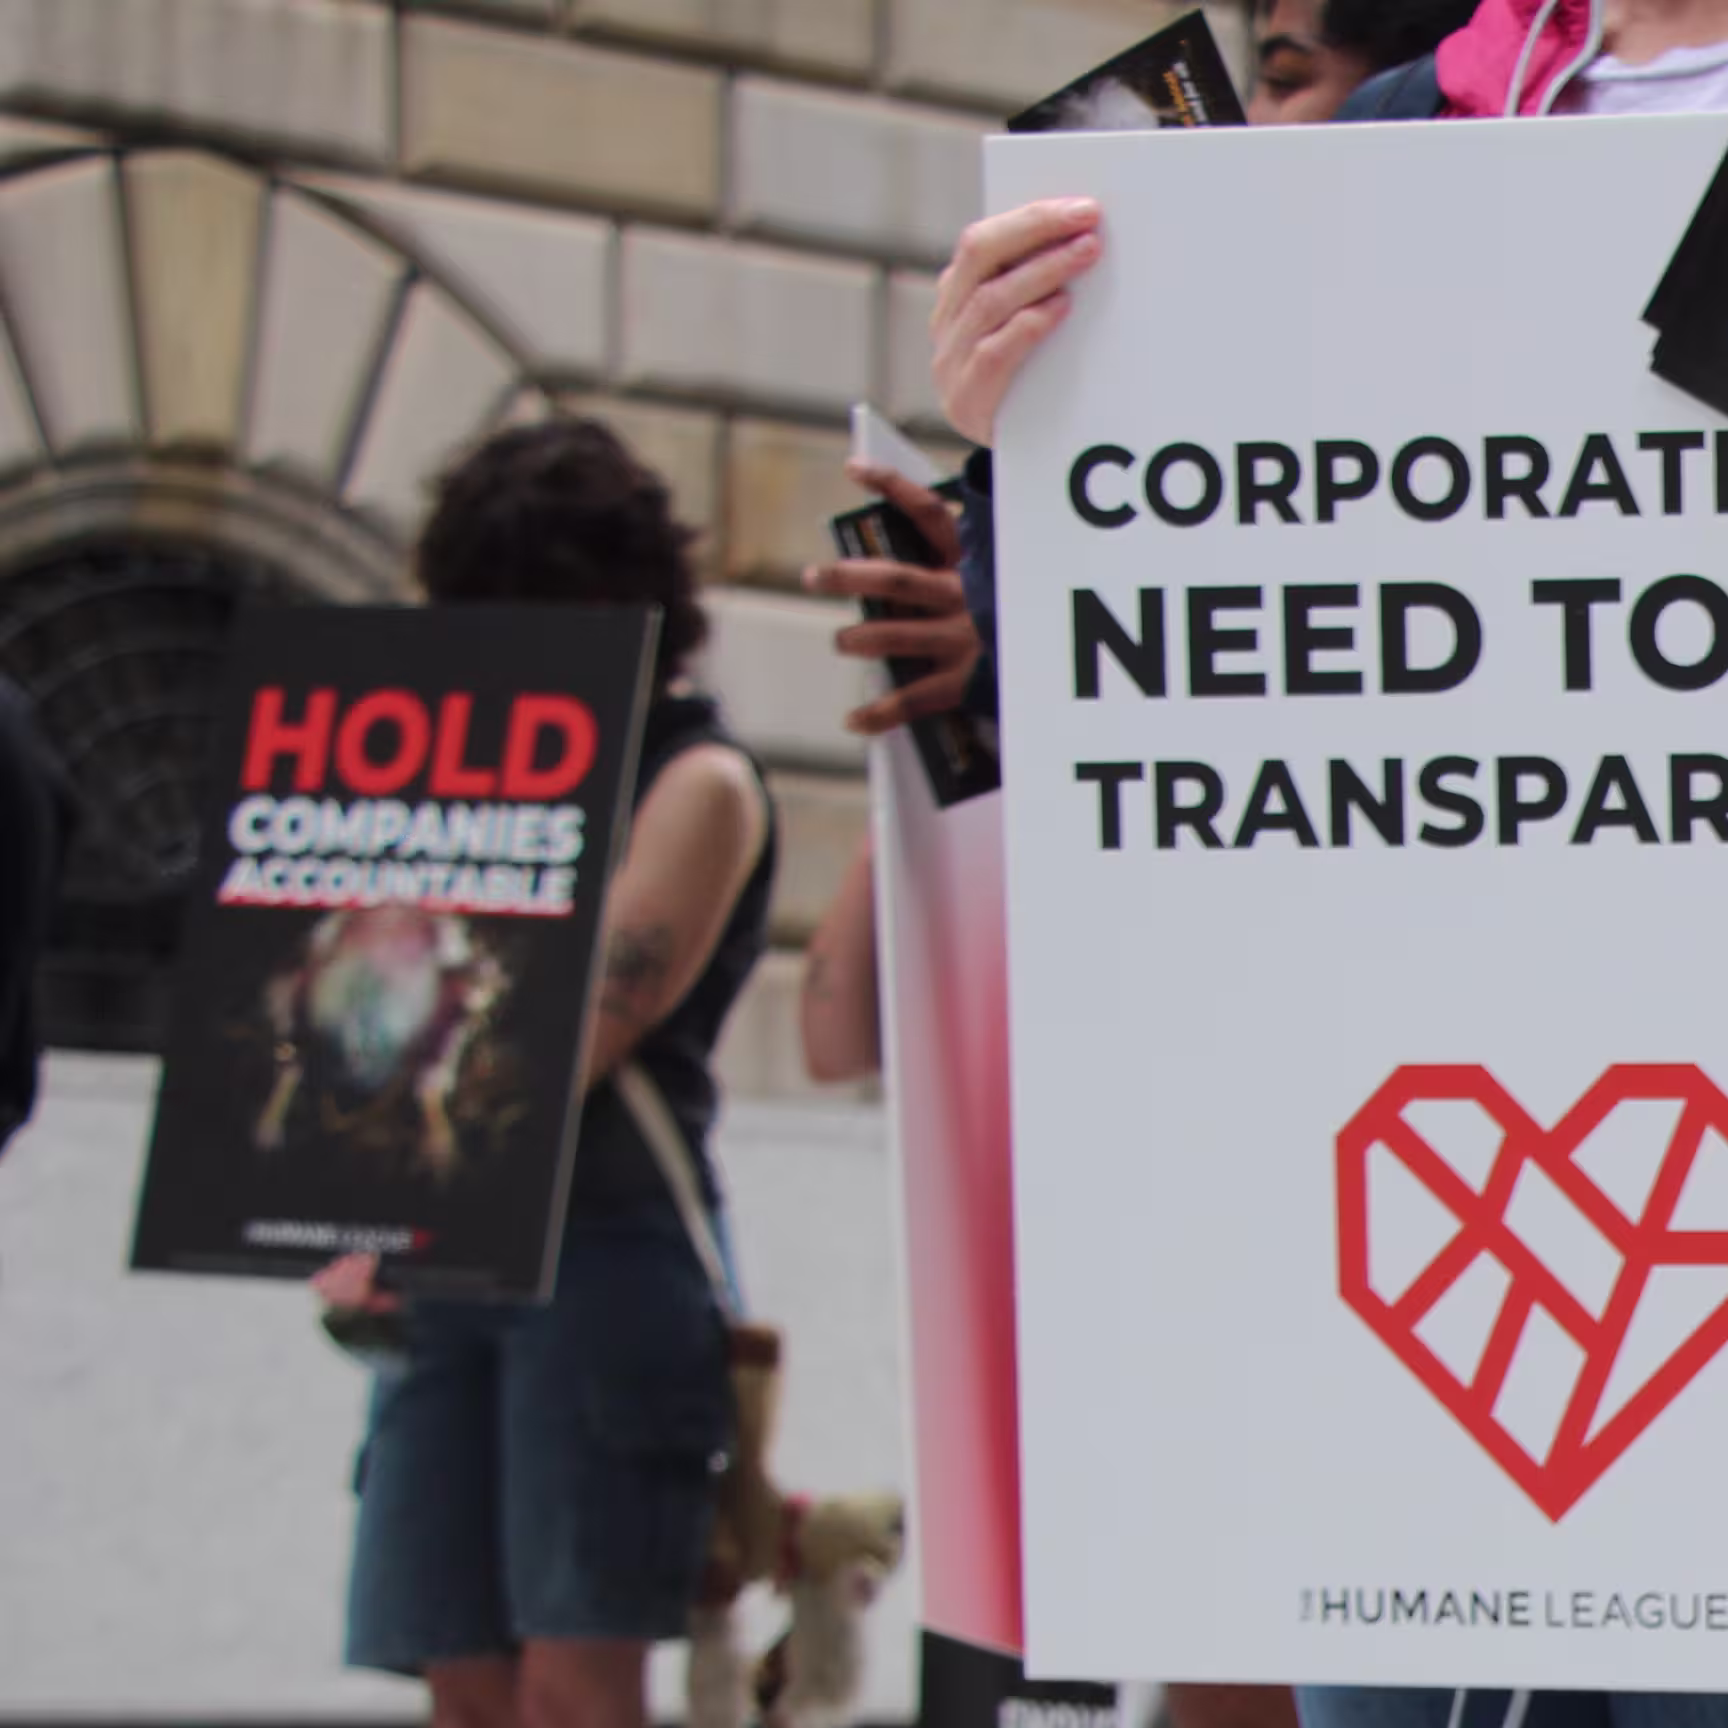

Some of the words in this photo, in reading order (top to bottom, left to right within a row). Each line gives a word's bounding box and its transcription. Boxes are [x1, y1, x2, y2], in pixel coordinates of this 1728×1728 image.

[1071, 581, 1483, 699] NEED
[243, 688, 598, 801] HOLD
[228, 794, 586, 864] COMPANIES
[218, 856, 577, 913] ACCOUNTABLE
[1320, 1588, 1531, 1627] HUMANE
[1545, 1591, 1728, 1631] LEAGUE
